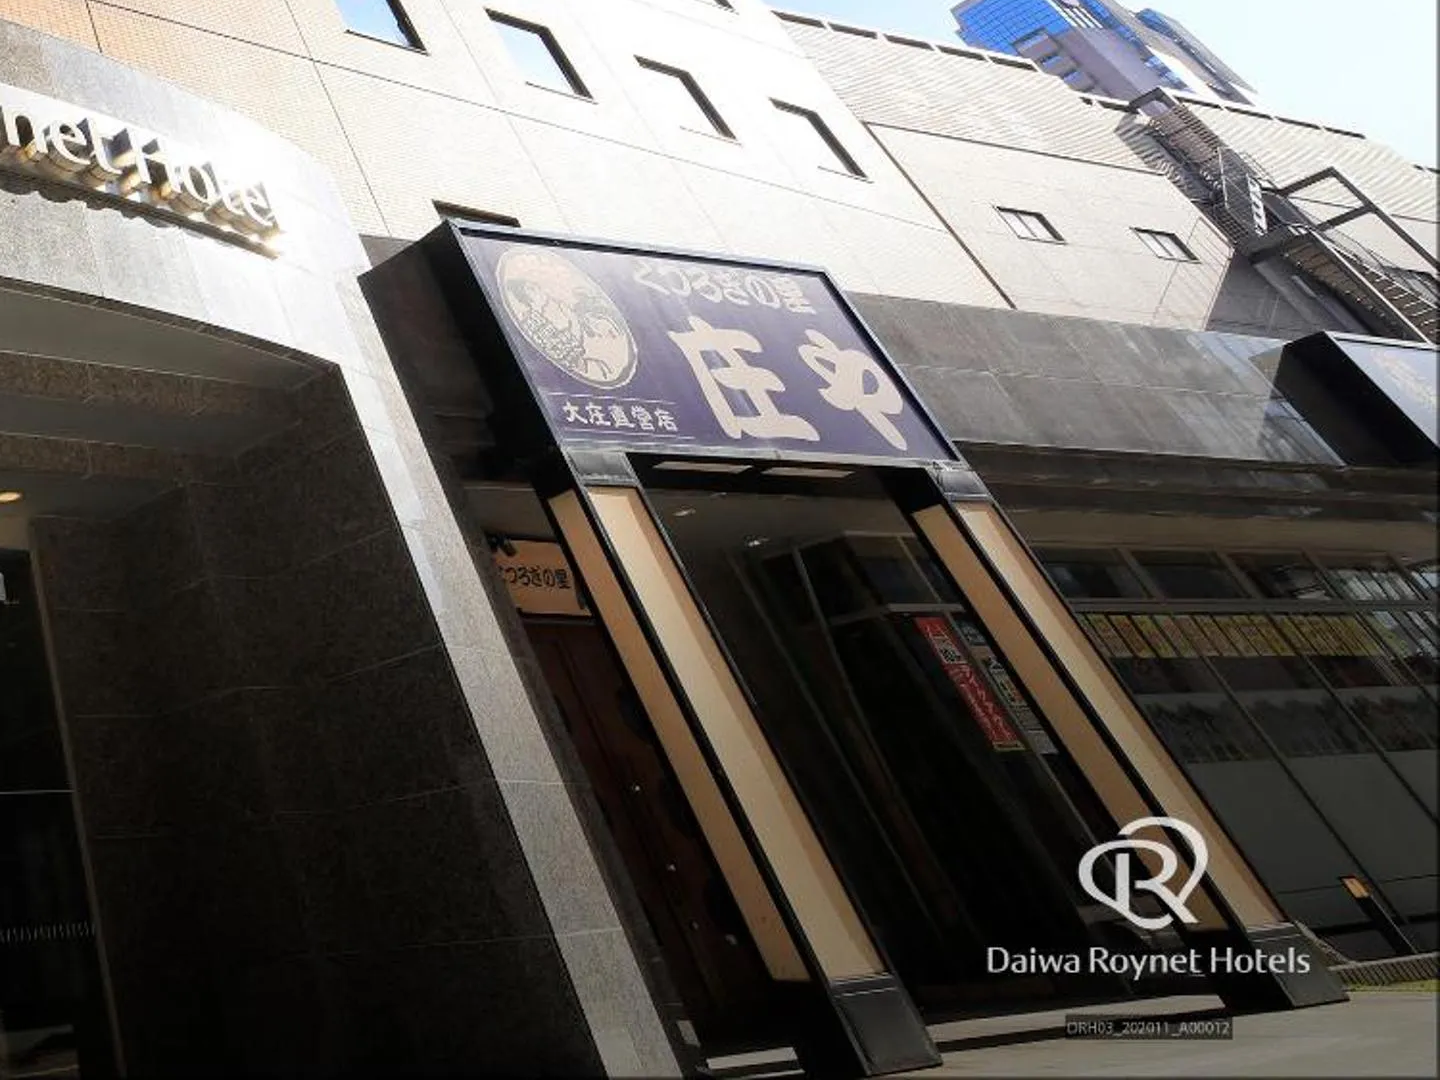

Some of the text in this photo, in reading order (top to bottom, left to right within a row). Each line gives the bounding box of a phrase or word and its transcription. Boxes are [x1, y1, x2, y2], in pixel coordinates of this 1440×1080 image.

[634, 259, 817, 315] くつろぎの里
[669, 316, 908, 452] 庄や
